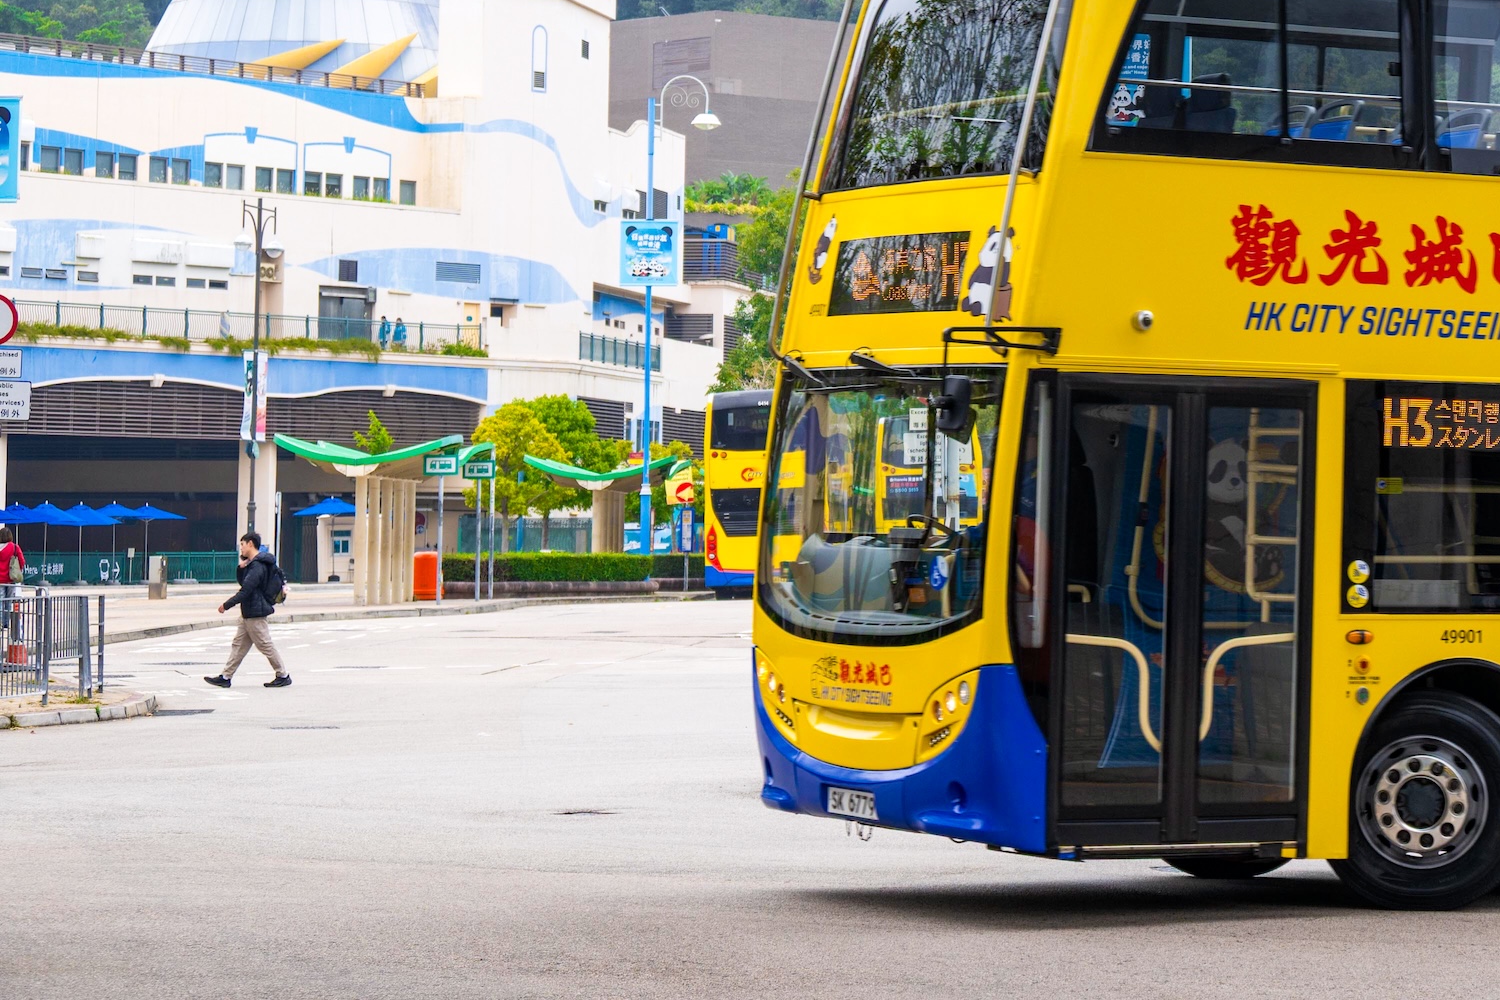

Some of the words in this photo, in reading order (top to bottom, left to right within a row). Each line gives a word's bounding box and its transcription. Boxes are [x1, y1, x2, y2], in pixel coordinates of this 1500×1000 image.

[1244, 302, 1286, 331] HK
[1289, 303, 1355, 334] CITY
[1383, 398, 1433, 448] H3
[1440, 629, 1483, 644] 49901
[839, 659, 893, 686] 觀光城巴
[845, 688, 893, 706] SIGHTSEEING
[831, 791, 844, 811] SK
[849, 792, 875, 816] 6779
